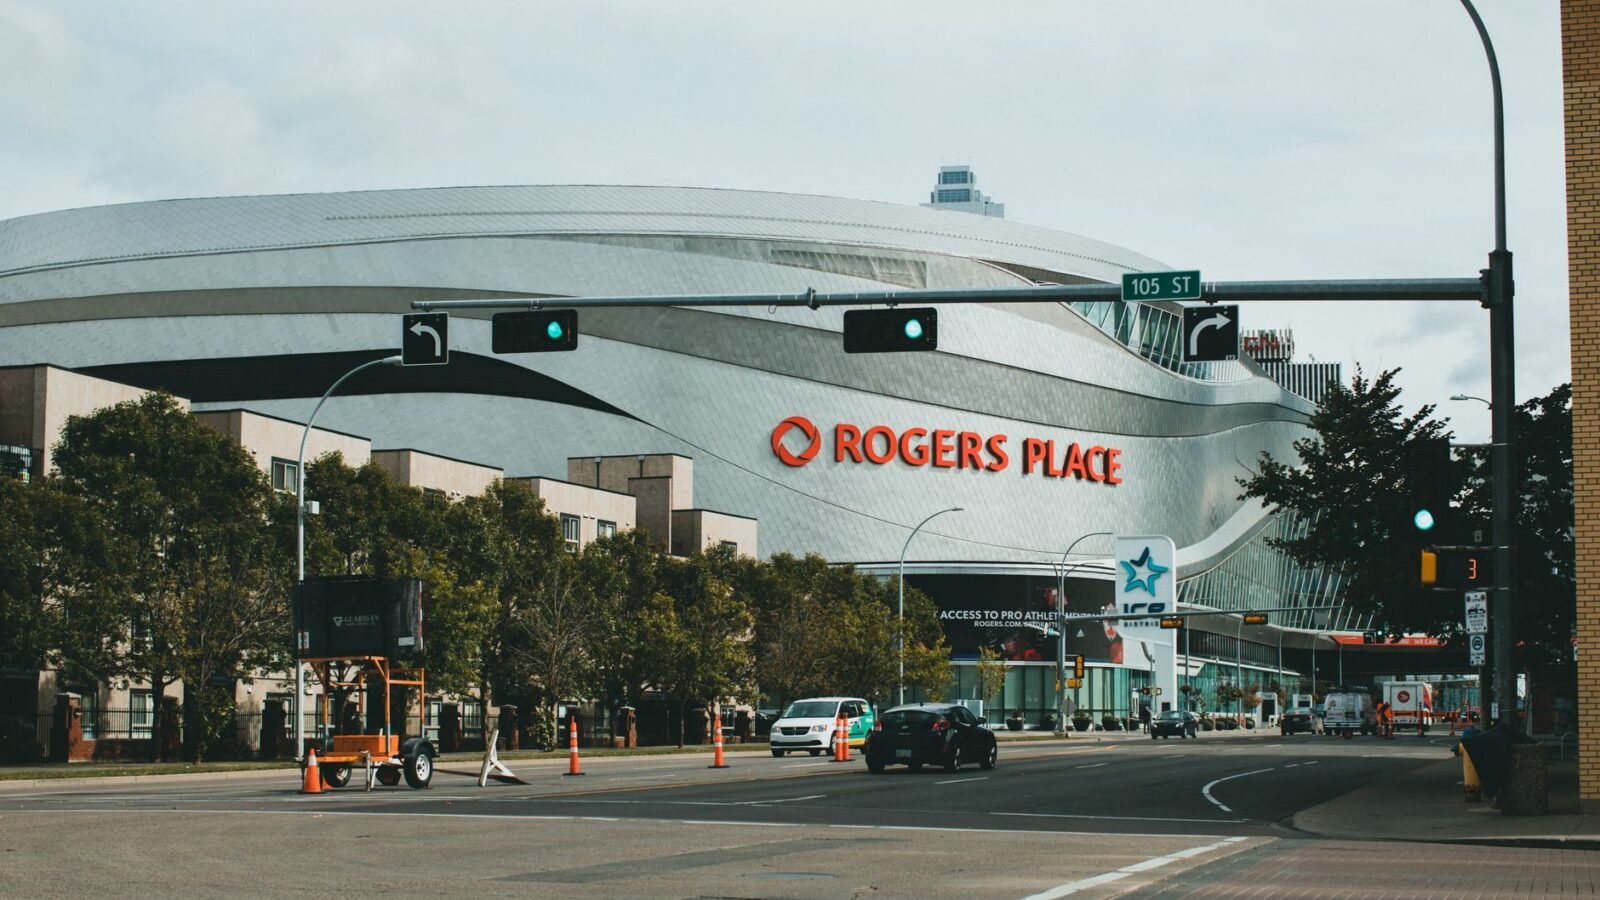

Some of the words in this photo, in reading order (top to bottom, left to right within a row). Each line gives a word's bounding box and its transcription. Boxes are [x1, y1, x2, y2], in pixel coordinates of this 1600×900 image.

[1131, 278, 1160, 295] 105
[1172, 276, 1192, 294] ST
[835, 423, 1010, 472] ROGERS
[1022, 437, 1123, 487] PLACE
[1468, 559, 1477, 580] 3
[940, 610, 982, 620] ACCESS
[984, 610, 999, 620] TO
[1001, 611, 1023, 620] PRO
[1024, 611, 1059, 621] ATHLET
